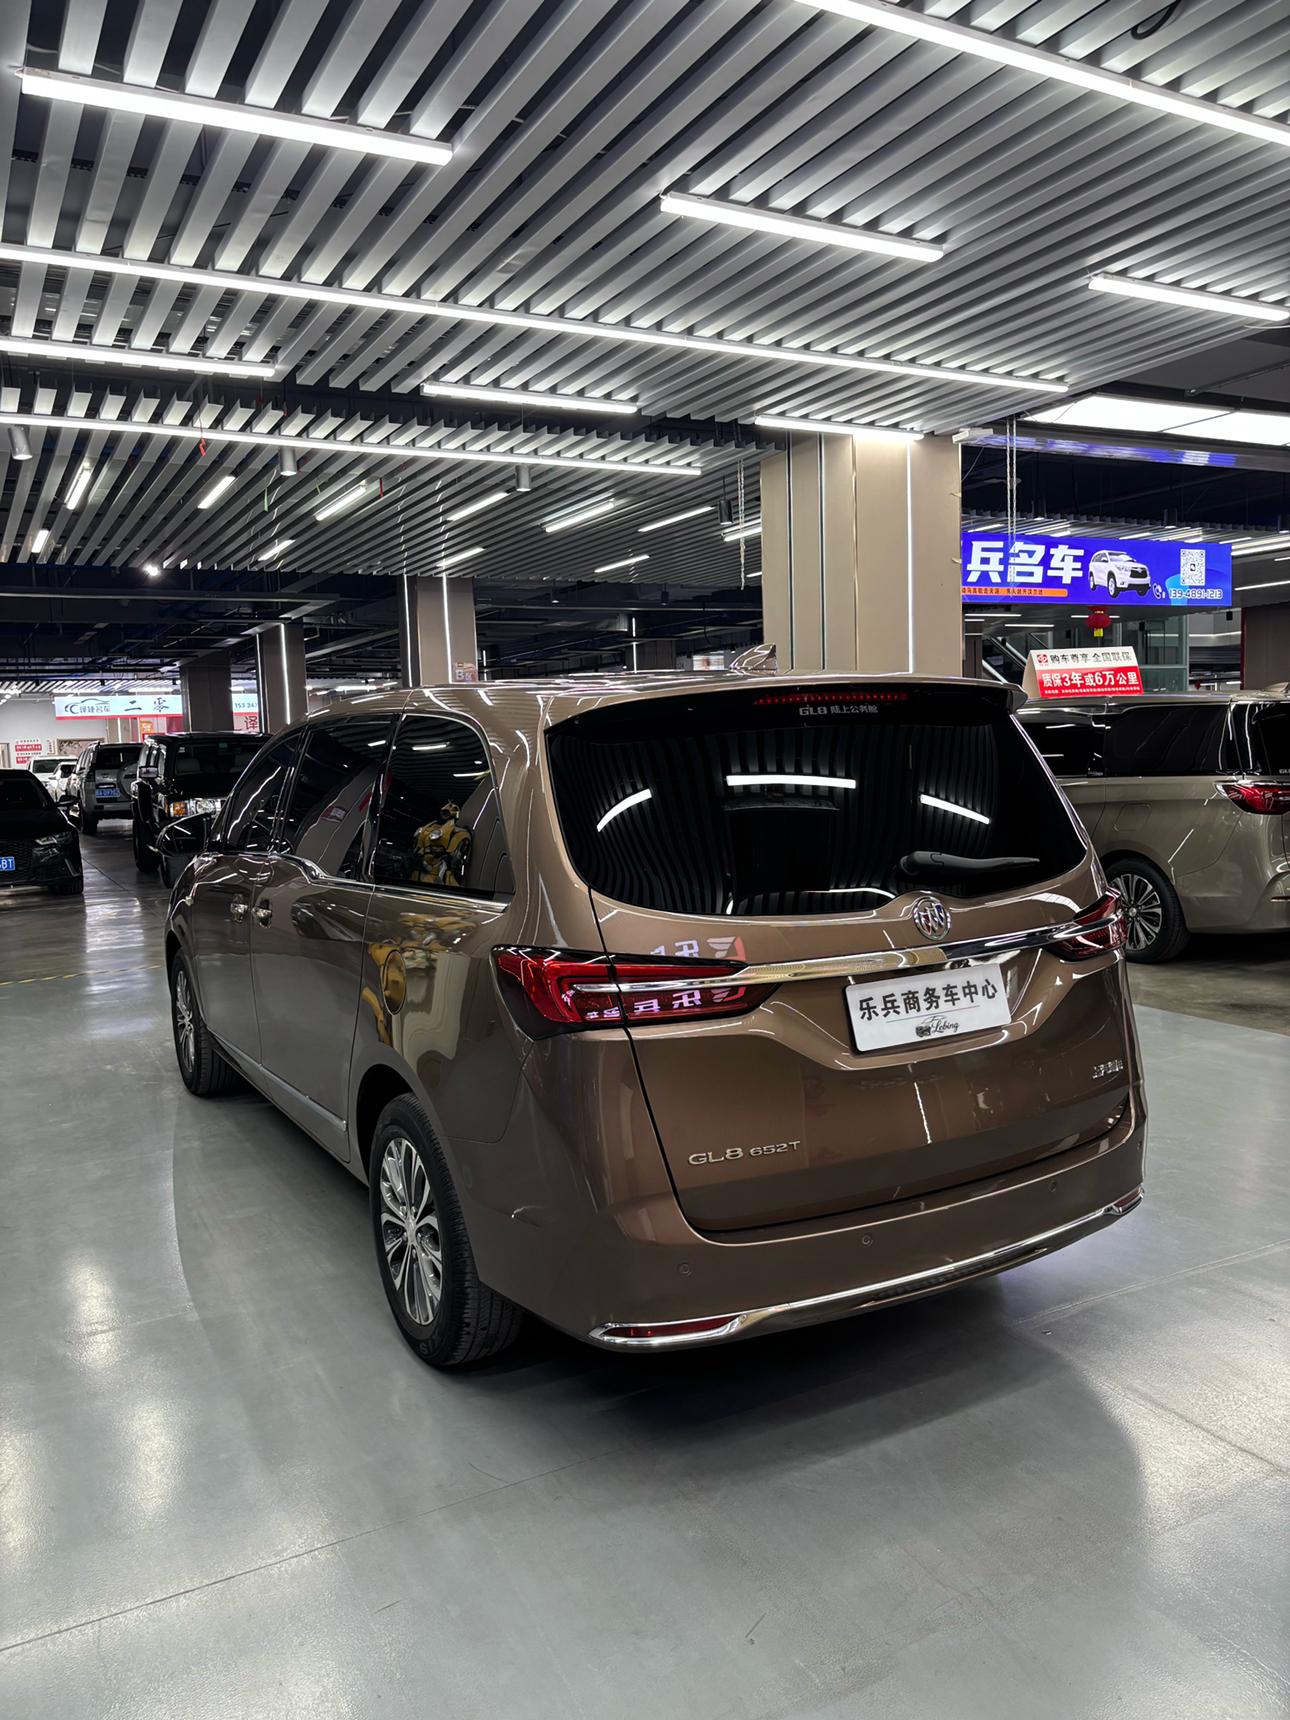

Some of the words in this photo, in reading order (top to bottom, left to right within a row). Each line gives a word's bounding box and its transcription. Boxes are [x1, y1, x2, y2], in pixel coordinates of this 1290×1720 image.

[1041, 671, 1140, 688] 质保3年或6万公里
[799, 706, 827, 716] GL8
[859, 978, 998, 1021] 乐兵商务车中心
[688, 1146, 745, 1167] GL8
[749, 1140, 801, 1157] 652T
